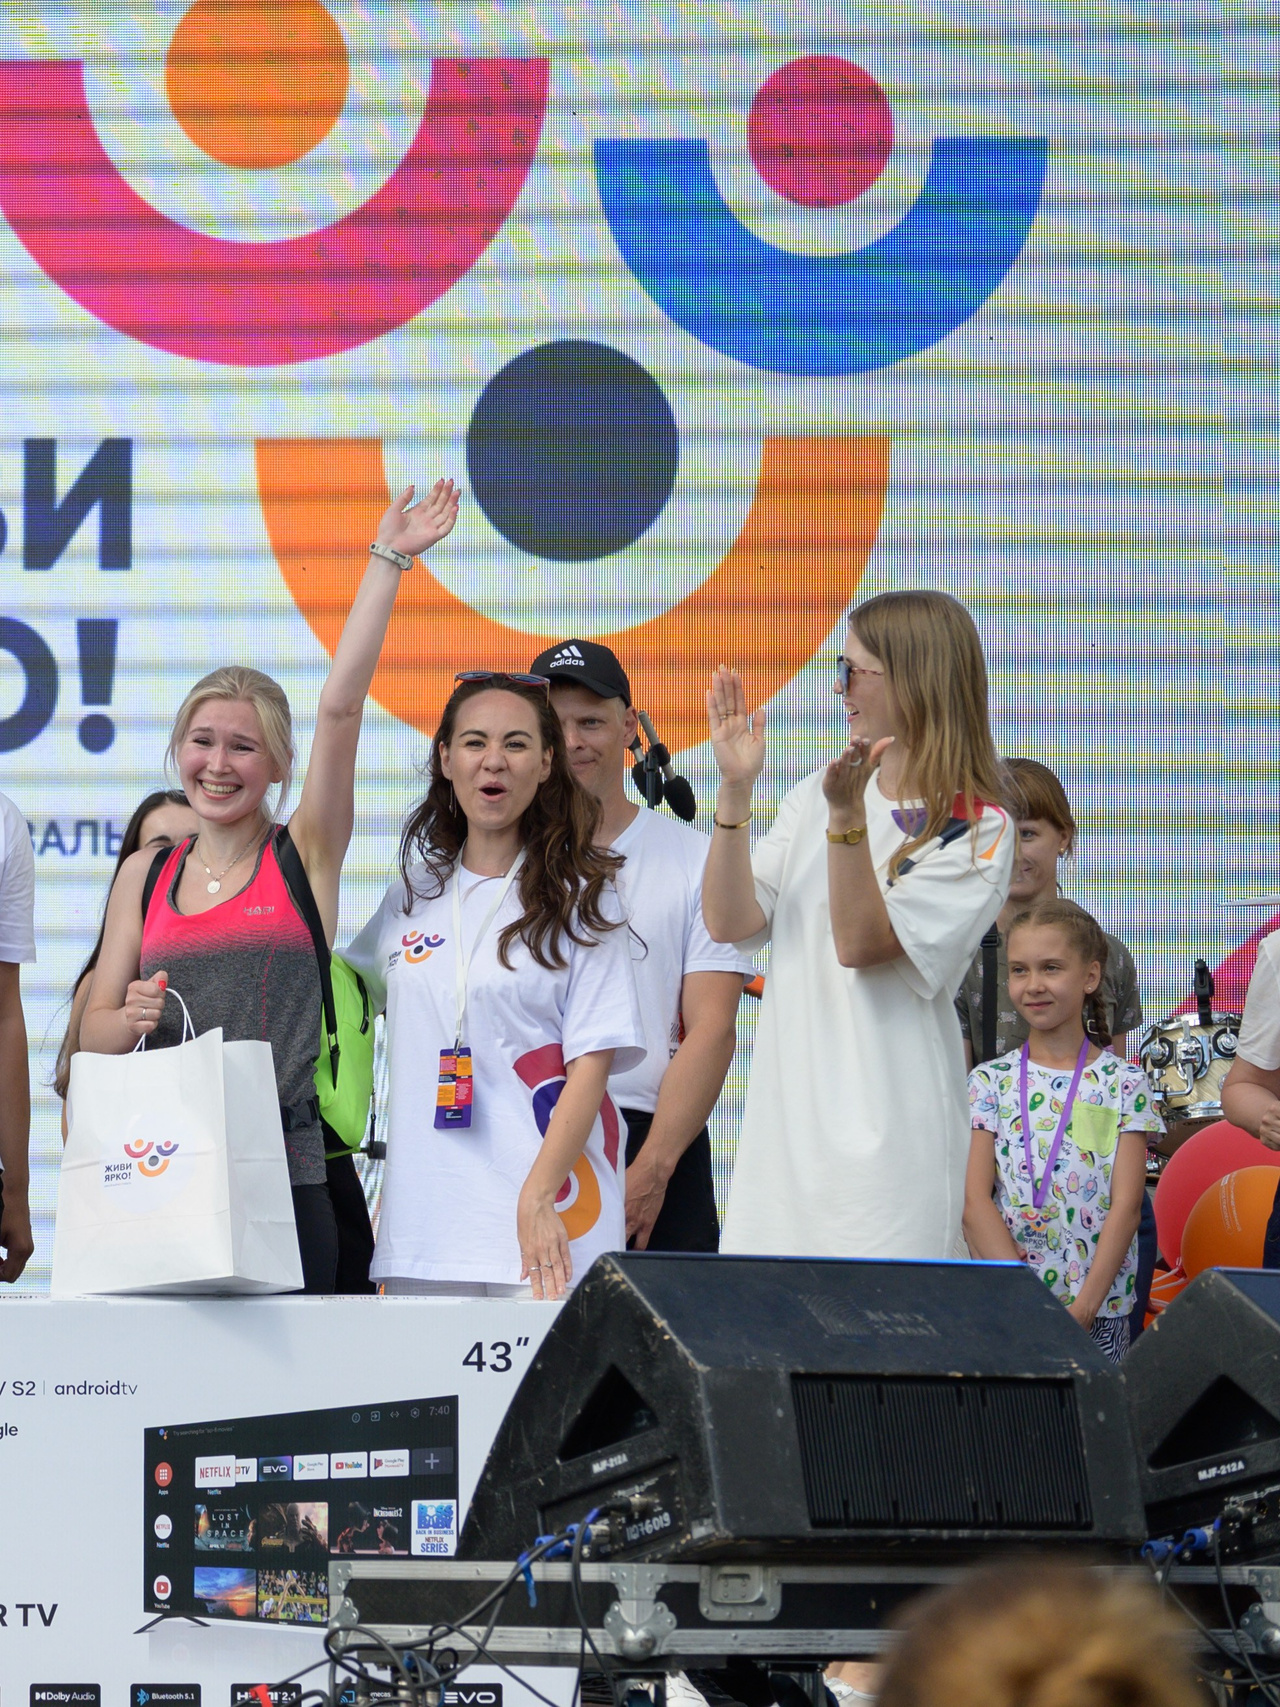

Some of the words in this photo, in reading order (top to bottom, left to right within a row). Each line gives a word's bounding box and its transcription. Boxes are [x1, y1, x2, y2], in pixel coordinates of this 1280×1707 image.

[550, 658, 584, 668] adidas
[104, 1162, 132, 1173] ЖИВИ
[104, 1172, 132, 1182] ЯРКО!
[12, 1381, 36, 1396] S2
[429, 1405, 450, 1416] 7:40
[262, 1465, 288, 1473] EVO
[345, 1461, 363, 1469] YouTube
[1198, 1460, 1245, 1480] MJF-212A
[200, 1466, 231, 1479] NETFLIX
[212, 1513, 239, 1521] LOST
[207, 1530, 244, 1538] SPACE
[421, 1543, 449, 1553] SERIES
[15, 1604, 58, 1627] TV
[46, 1691, 70, 1702] Dolby
[71, 1691, 95, 1701] Audio
[152, 1692, 182, 1700] Bluetooth
[184, 1692, 194, 1700] 5.1
[281, 1692, 296, 1700] 2.1
[444, 1691, 496, 1704] EVO
